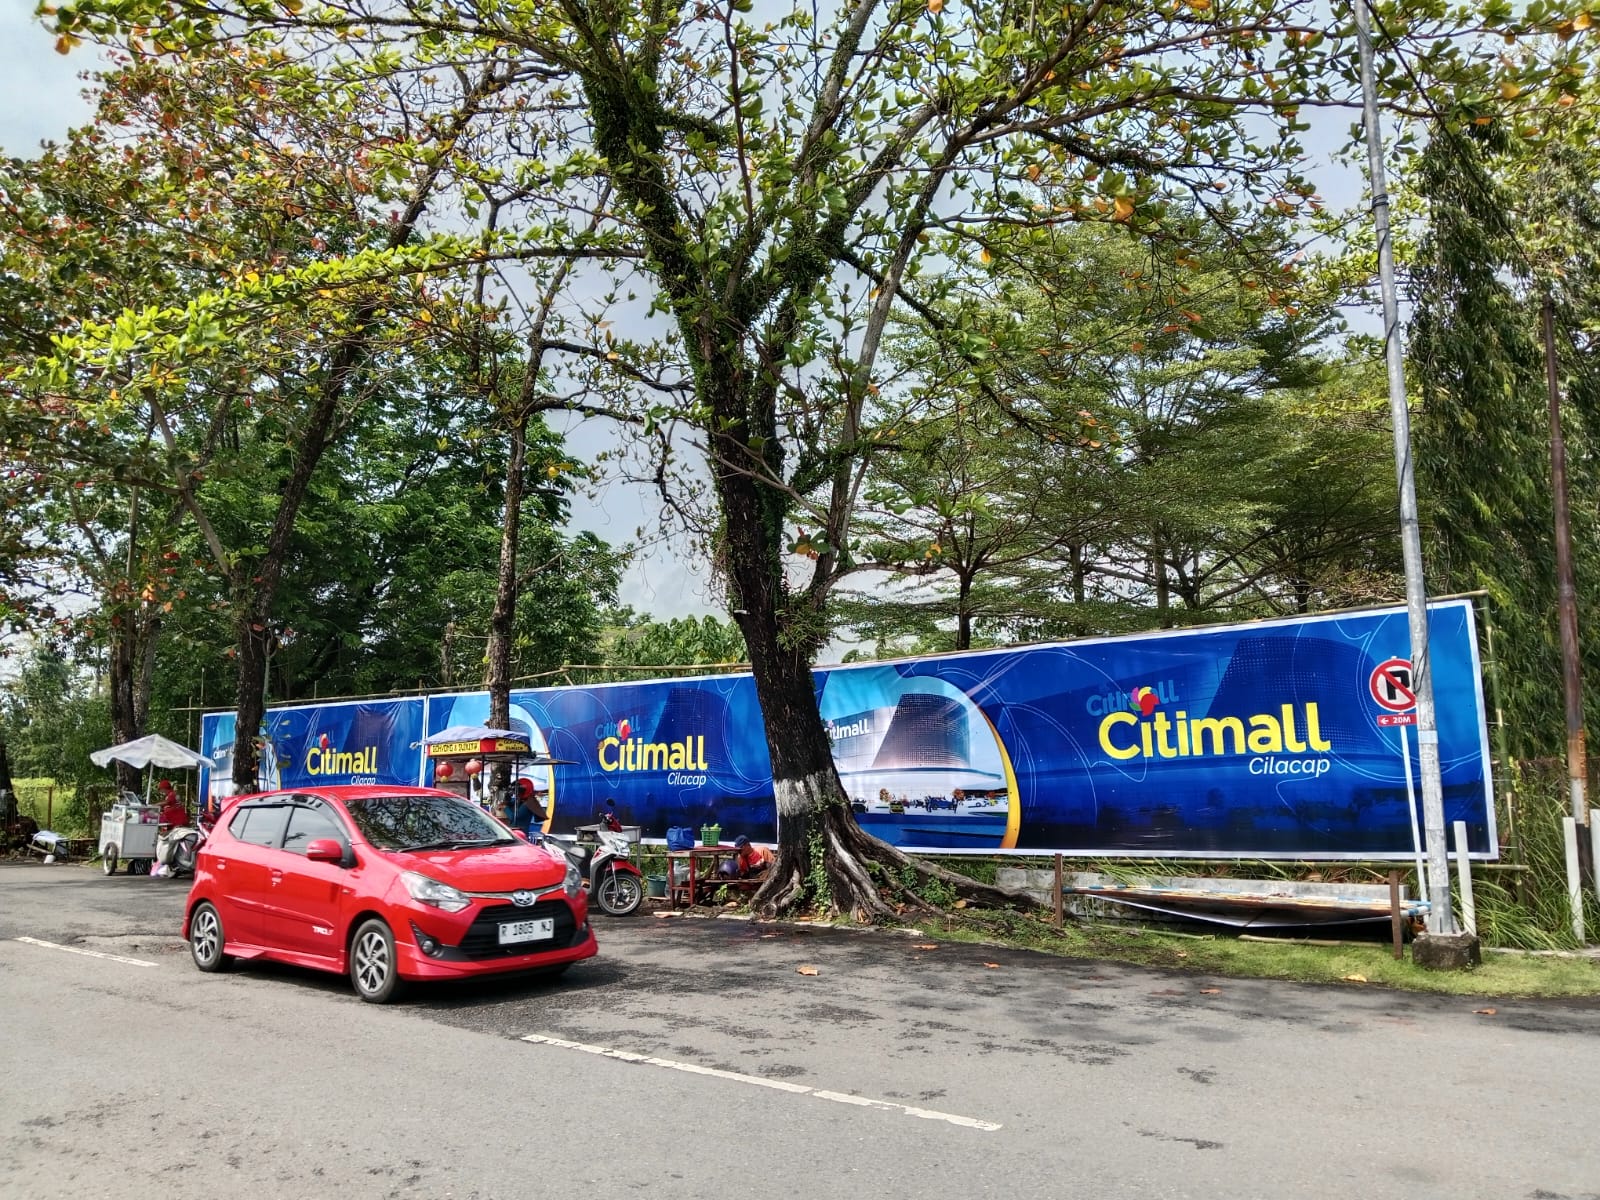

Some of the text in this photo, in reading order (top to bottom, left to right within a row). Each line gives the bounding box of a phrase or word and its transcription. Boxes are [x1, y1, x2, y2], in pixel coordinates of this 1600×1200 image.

[1098, 702, 1331, 760] Citimall
[1392, 716, 1412, 724] 20M
[306, 746, 378, 776] Citimall
[598, 735, 708, 772] Citimall
[1249, 757, 1331, 777] Cilacap
[667, 772, 707, 789] Cilacap
